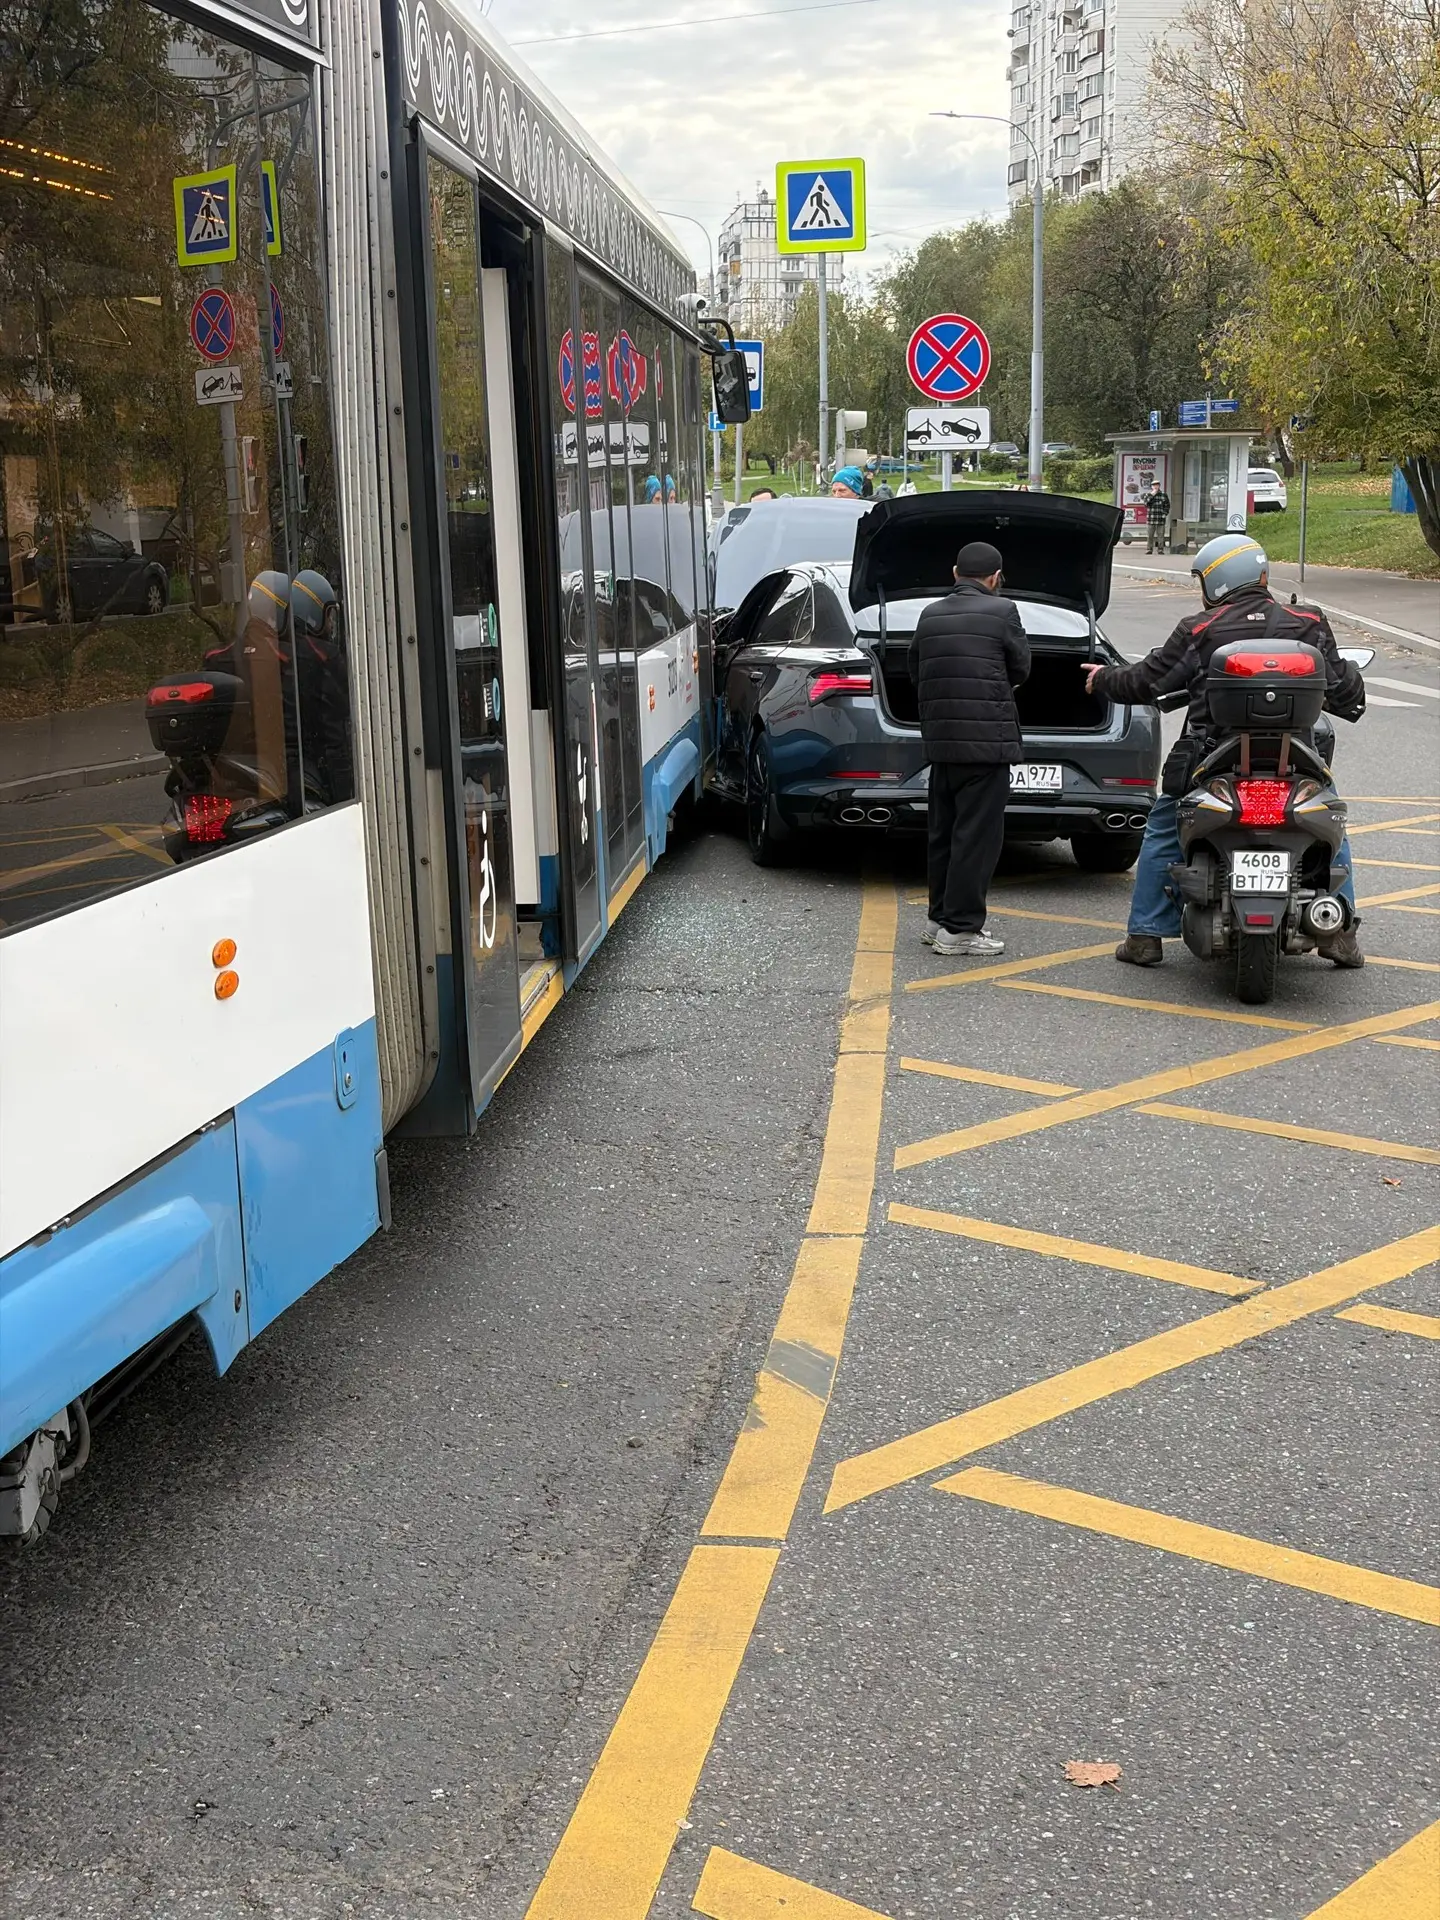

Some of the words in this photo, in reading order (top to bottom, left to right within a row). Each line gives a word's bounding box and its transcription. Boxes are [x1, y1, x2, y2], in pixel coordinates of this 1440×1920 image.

[1029, 766, 1057, 781] 977
[1241, 854, 1281, 868] 4608
[1236, 875, 1259, 889] ВТ
[1265, 876, 1285, 889] 77
